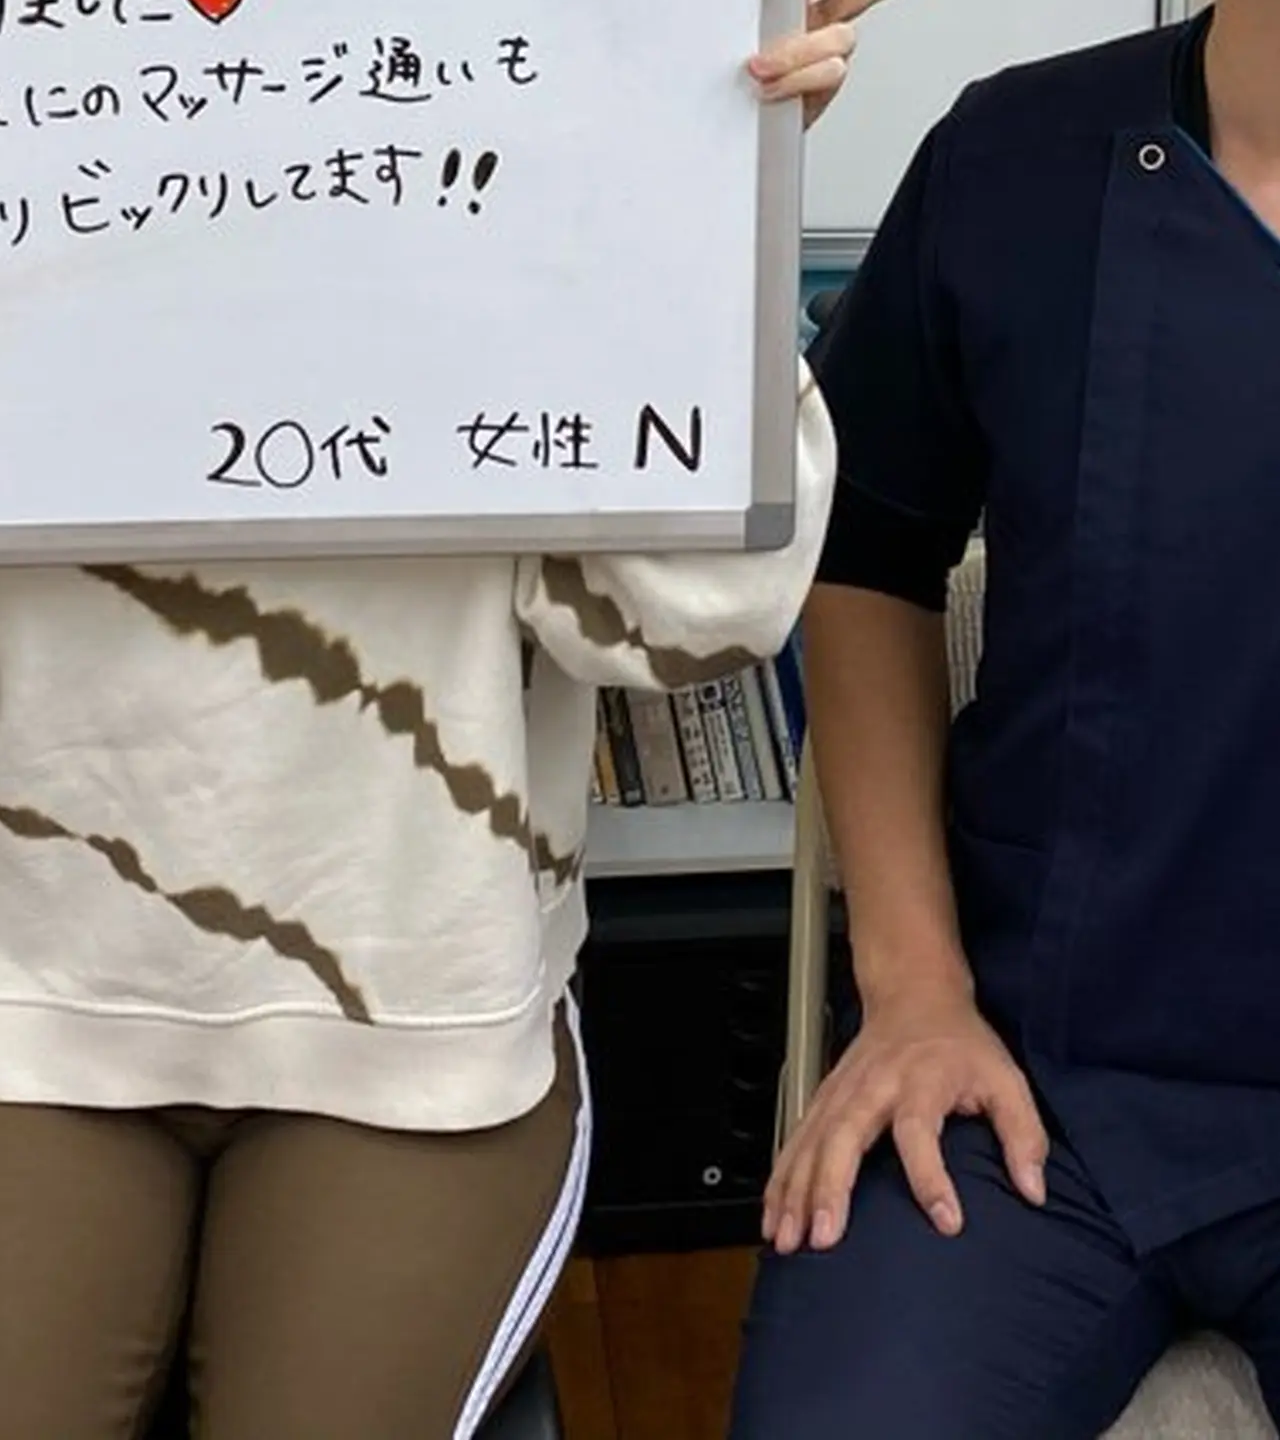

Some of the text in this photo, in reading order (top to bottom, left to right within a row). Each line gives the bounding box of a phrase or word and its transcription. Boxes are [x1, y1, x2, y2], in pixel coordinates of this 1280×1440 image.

[206, 402, 703, 489] 20代 女性 N
